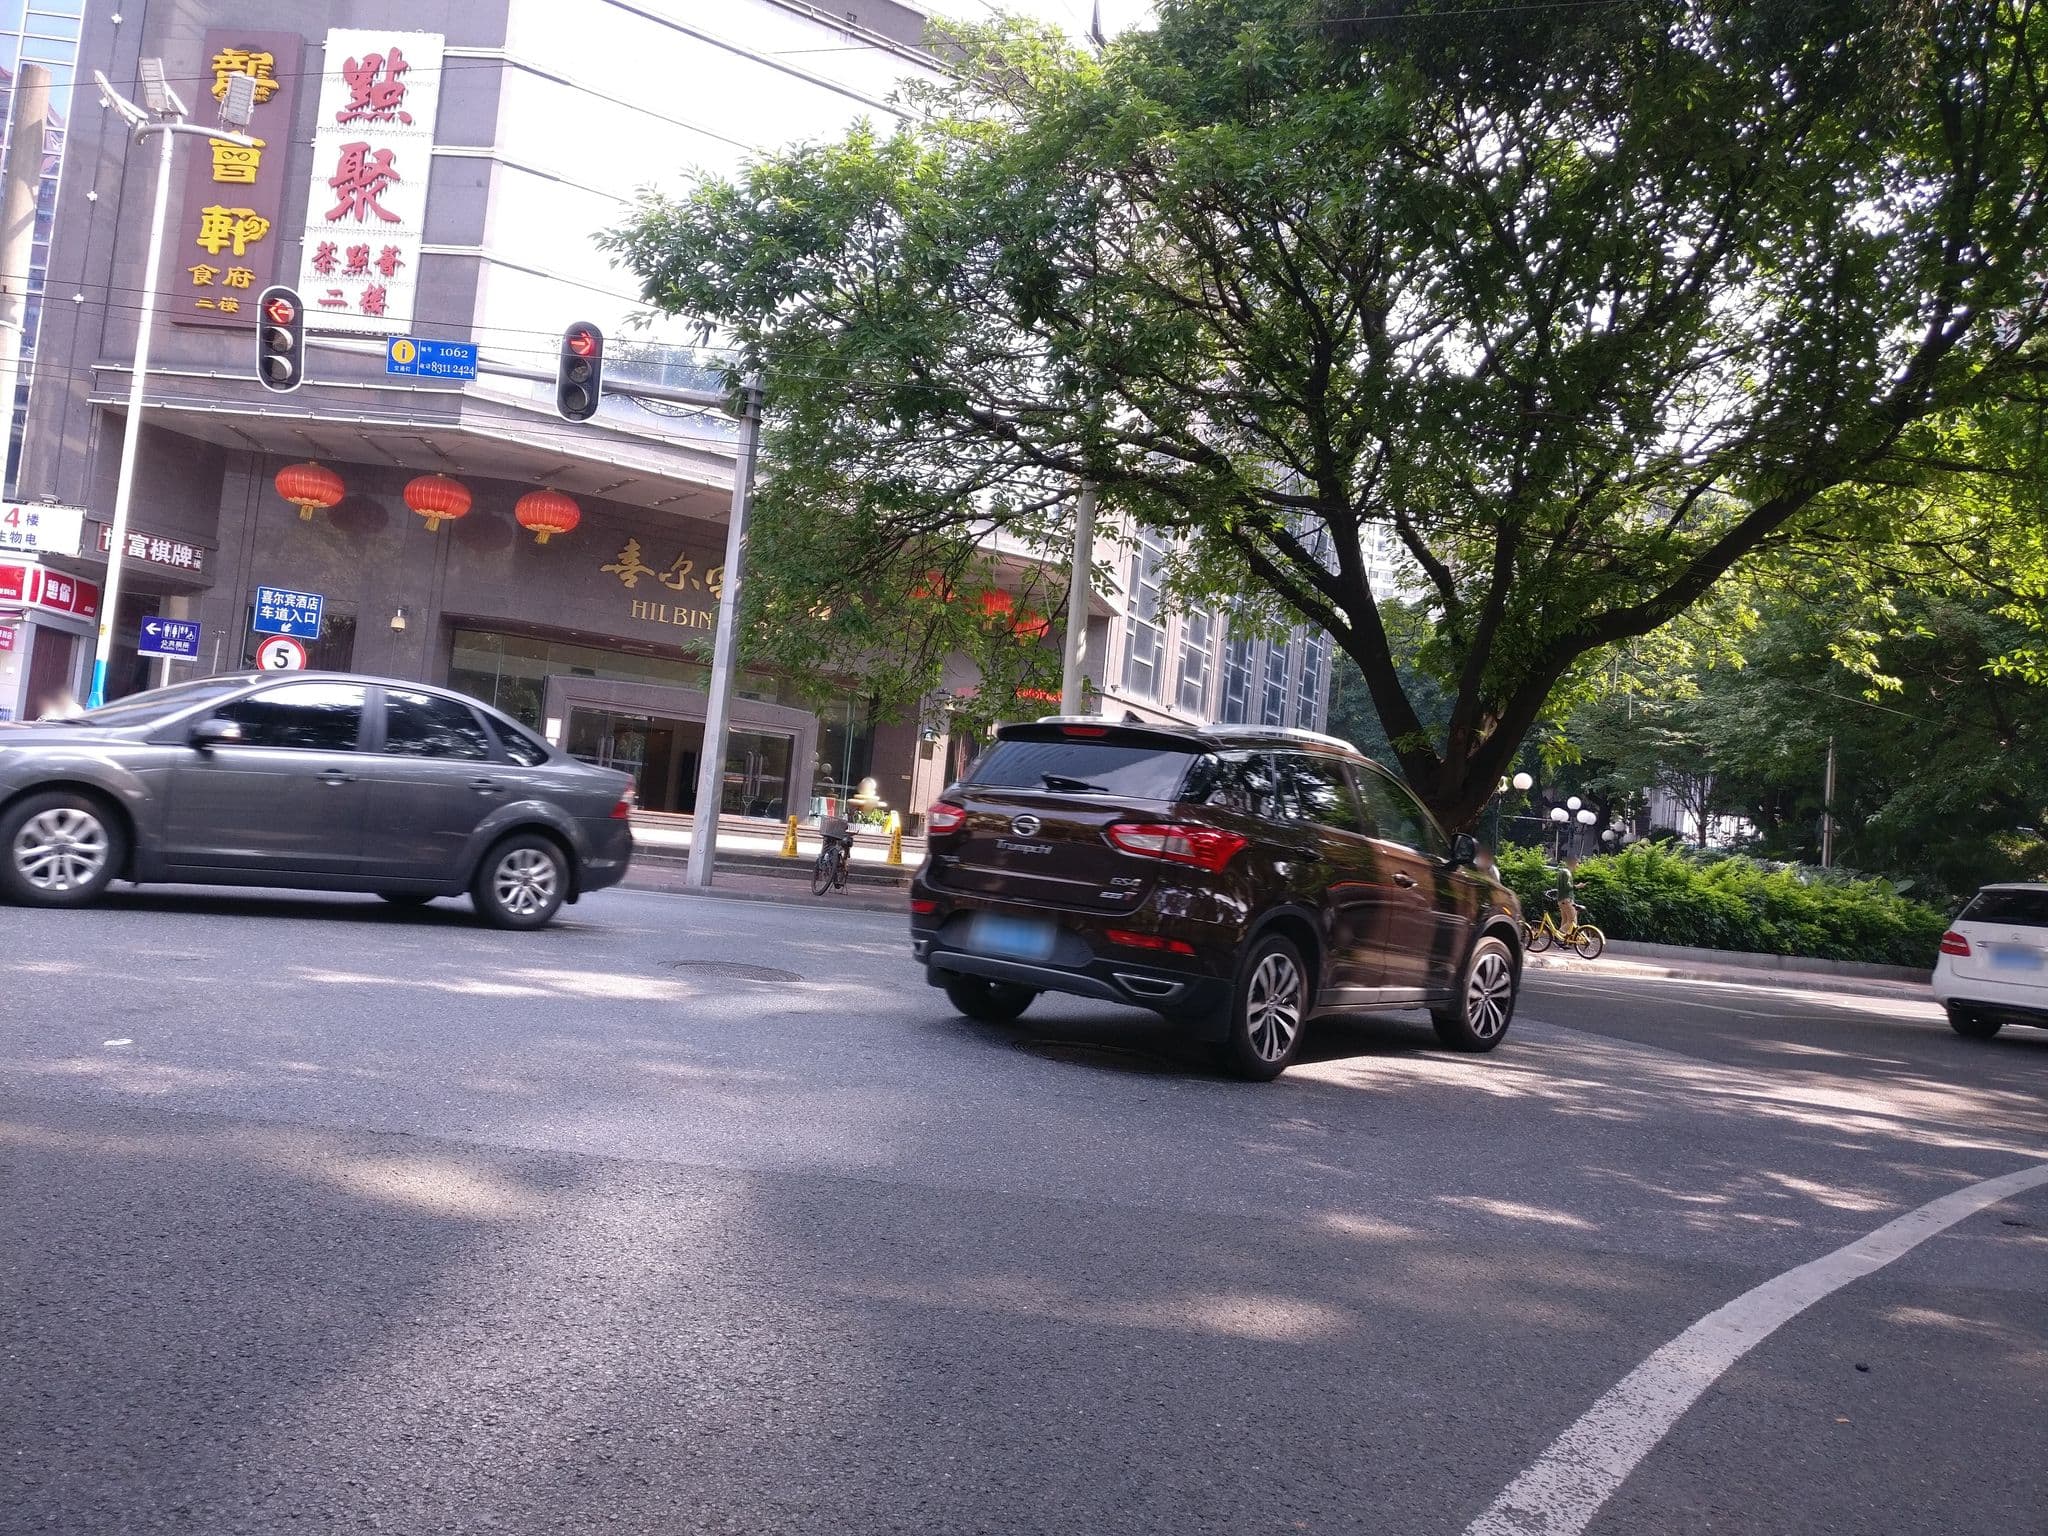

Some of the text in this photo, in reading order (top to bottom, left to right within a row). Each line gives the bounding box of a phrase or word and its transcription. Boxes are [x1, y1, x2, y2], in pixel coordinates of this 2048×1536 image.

[325, 47, 413, 223] 點聚
[187, 264, 256, 289] 食府
[440, 347, 469, 359] 1062
[261, 590, 319, 611] 喜尔宾酒店
[260, 605, 317, 625] 车道入口
[630, 600, 713, 630] HILBIN
[273, 647, 290, 669] 5
